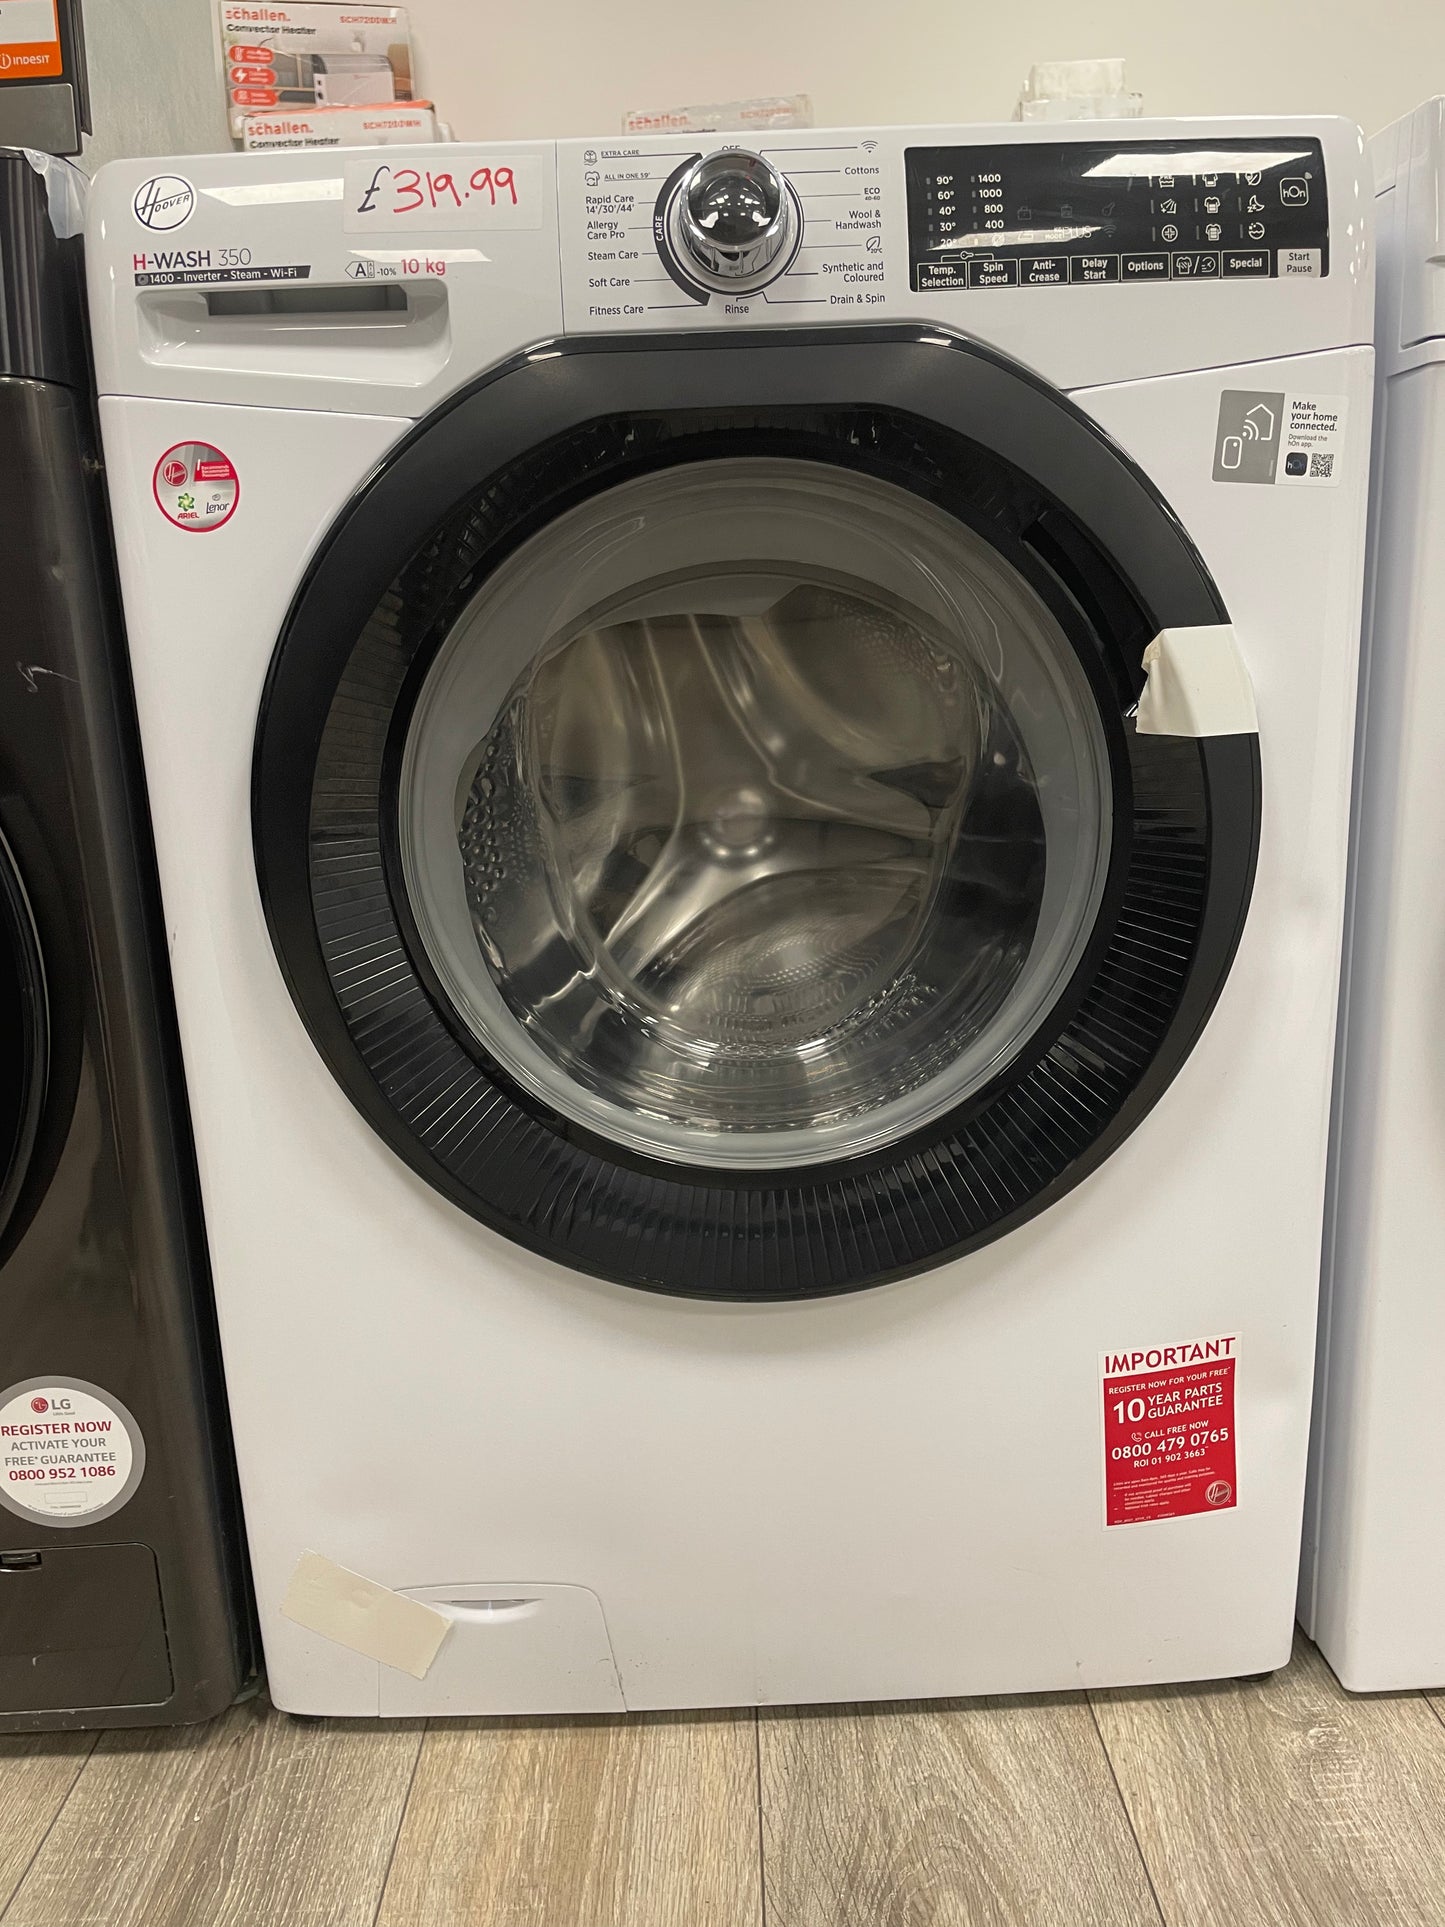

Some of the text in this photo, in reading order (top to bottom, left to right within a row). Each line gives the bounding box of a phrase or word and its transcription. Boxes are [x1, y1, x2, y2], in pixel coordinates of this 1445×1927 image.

[226, 24, 317, 35] Convector Heater
[250, 136, 340, 149] Convector Heater
[844, 166, 880, 175] Cottons
[936, 176, 953, 185] 90°
[978, 173, 1001, 183] 1400
[357, 165, 518, 214] £319.99
[864, 187, 880, 195] ECO
[937, 190, 954, 200] 60°
[979, 188, 1002, 198] 1000
[1283, 186, 1306, 198] hOn
[586, 194, 634, 205] Rapid Care
[586, 204, 635, 215] 14'/30'/44'
[849, 209, 881, 219] Wool &
[939, 206, 956, 216] 40°
[984, 204, 1003, 213] 800
[587, 221, 618, 231] Allergy
[655, 215, 664, 241] CARE
[835, 220, 881, 230] Handwash
[940, 222, 956, 232] 30°
[985, 220, 1004, 229] 400
[587, 231, 625, 240] Care Pro
[1062, 225, 1092, 239] PLUS
[940, 238, 957, 248] 20°
[133, 248, 251, 270] H-WASH 350
[588, 250, 639, 261] Steam Care
[1288, 252, 1310, 261] Start
[401, 257, 446, 276] 10 kg
[822, 261, 884, 274] Synthetic and
[983, 262, 1004, 273] Spin
[1032, 260, 1056, 270] Anti-
[1082, 258, 1108, 269] Delay
[1127, 261, 1164, 273] Options
[1229, 257, 1262, 269] Special
[1286, 264, 1312, 273] Pause
[355, 263, 367, 277] A
[376, 267, 397, 277] -10%
[928, 266, 957, 276] Temp.
[1083, 270, 1106, 280] Start
[150, 273, 174, 284] 1400
[183, 271, 221, 282] Inverter
[230, 270, 261, 280] Steam
[270, 268, 297, 278] Wi-Fi
[843, 272, 884, 283] Coloured
[979, 273, 1008, 285] Speed
[1029, 272, 1060, 282] Crease
[589, 277, 630, 288] Soft Care
[921, 278, 964, 287] Selection
[830, 293, 886, 304] Drain & Spin
[589, 305, 644, 316] Fitness Care
[725, 304, 750, 314] Rinse
[1292, 401, 1317, 411] Make
[1291, 412, 1338, 422] your home
[1290, 421, 1338, 432] connected.
[1288, 434, 1317, 442] Download
[206, 502, 230, 514] Lenor
[177, 511, 200, 520] ARIEL
[1104, 1337, 1236, 1374] IMPORTANT
[1108, 1382, 1146, 1395] REGISTER
[1148, 1379, 1167, 1389] NOW
[1168, 1376, 1184, 1386] FOR
[1186, 1372, 1208, 1383] YOUR
[1147, 1382, 1222, 1406] YEAR PARTS
[51, 1398, 71, 1410] LG
[1147, 1394, 1224, 1419] GUARANTEE
[1113, 1397, 1146, 1425] 10
[1, 1420, 112, 1436] REGISTER NOW
[1144, 1420, 1209, 1440] CALL FREE NOW
[11, 1437, 106, 1451] ACTIVATE YOUR
[1111, 1427, 1229, 1461] 0800 479 0765
[40, 1452, 116, 1465] GUARANTEE
[1133, 1459, 1149, 1469] ROI
[1151, 1456, 1162, 1466] 01
[1165, 1453, 1182, 1463] 902
[9, 1465, 116, 1481] 0800 952 1086
